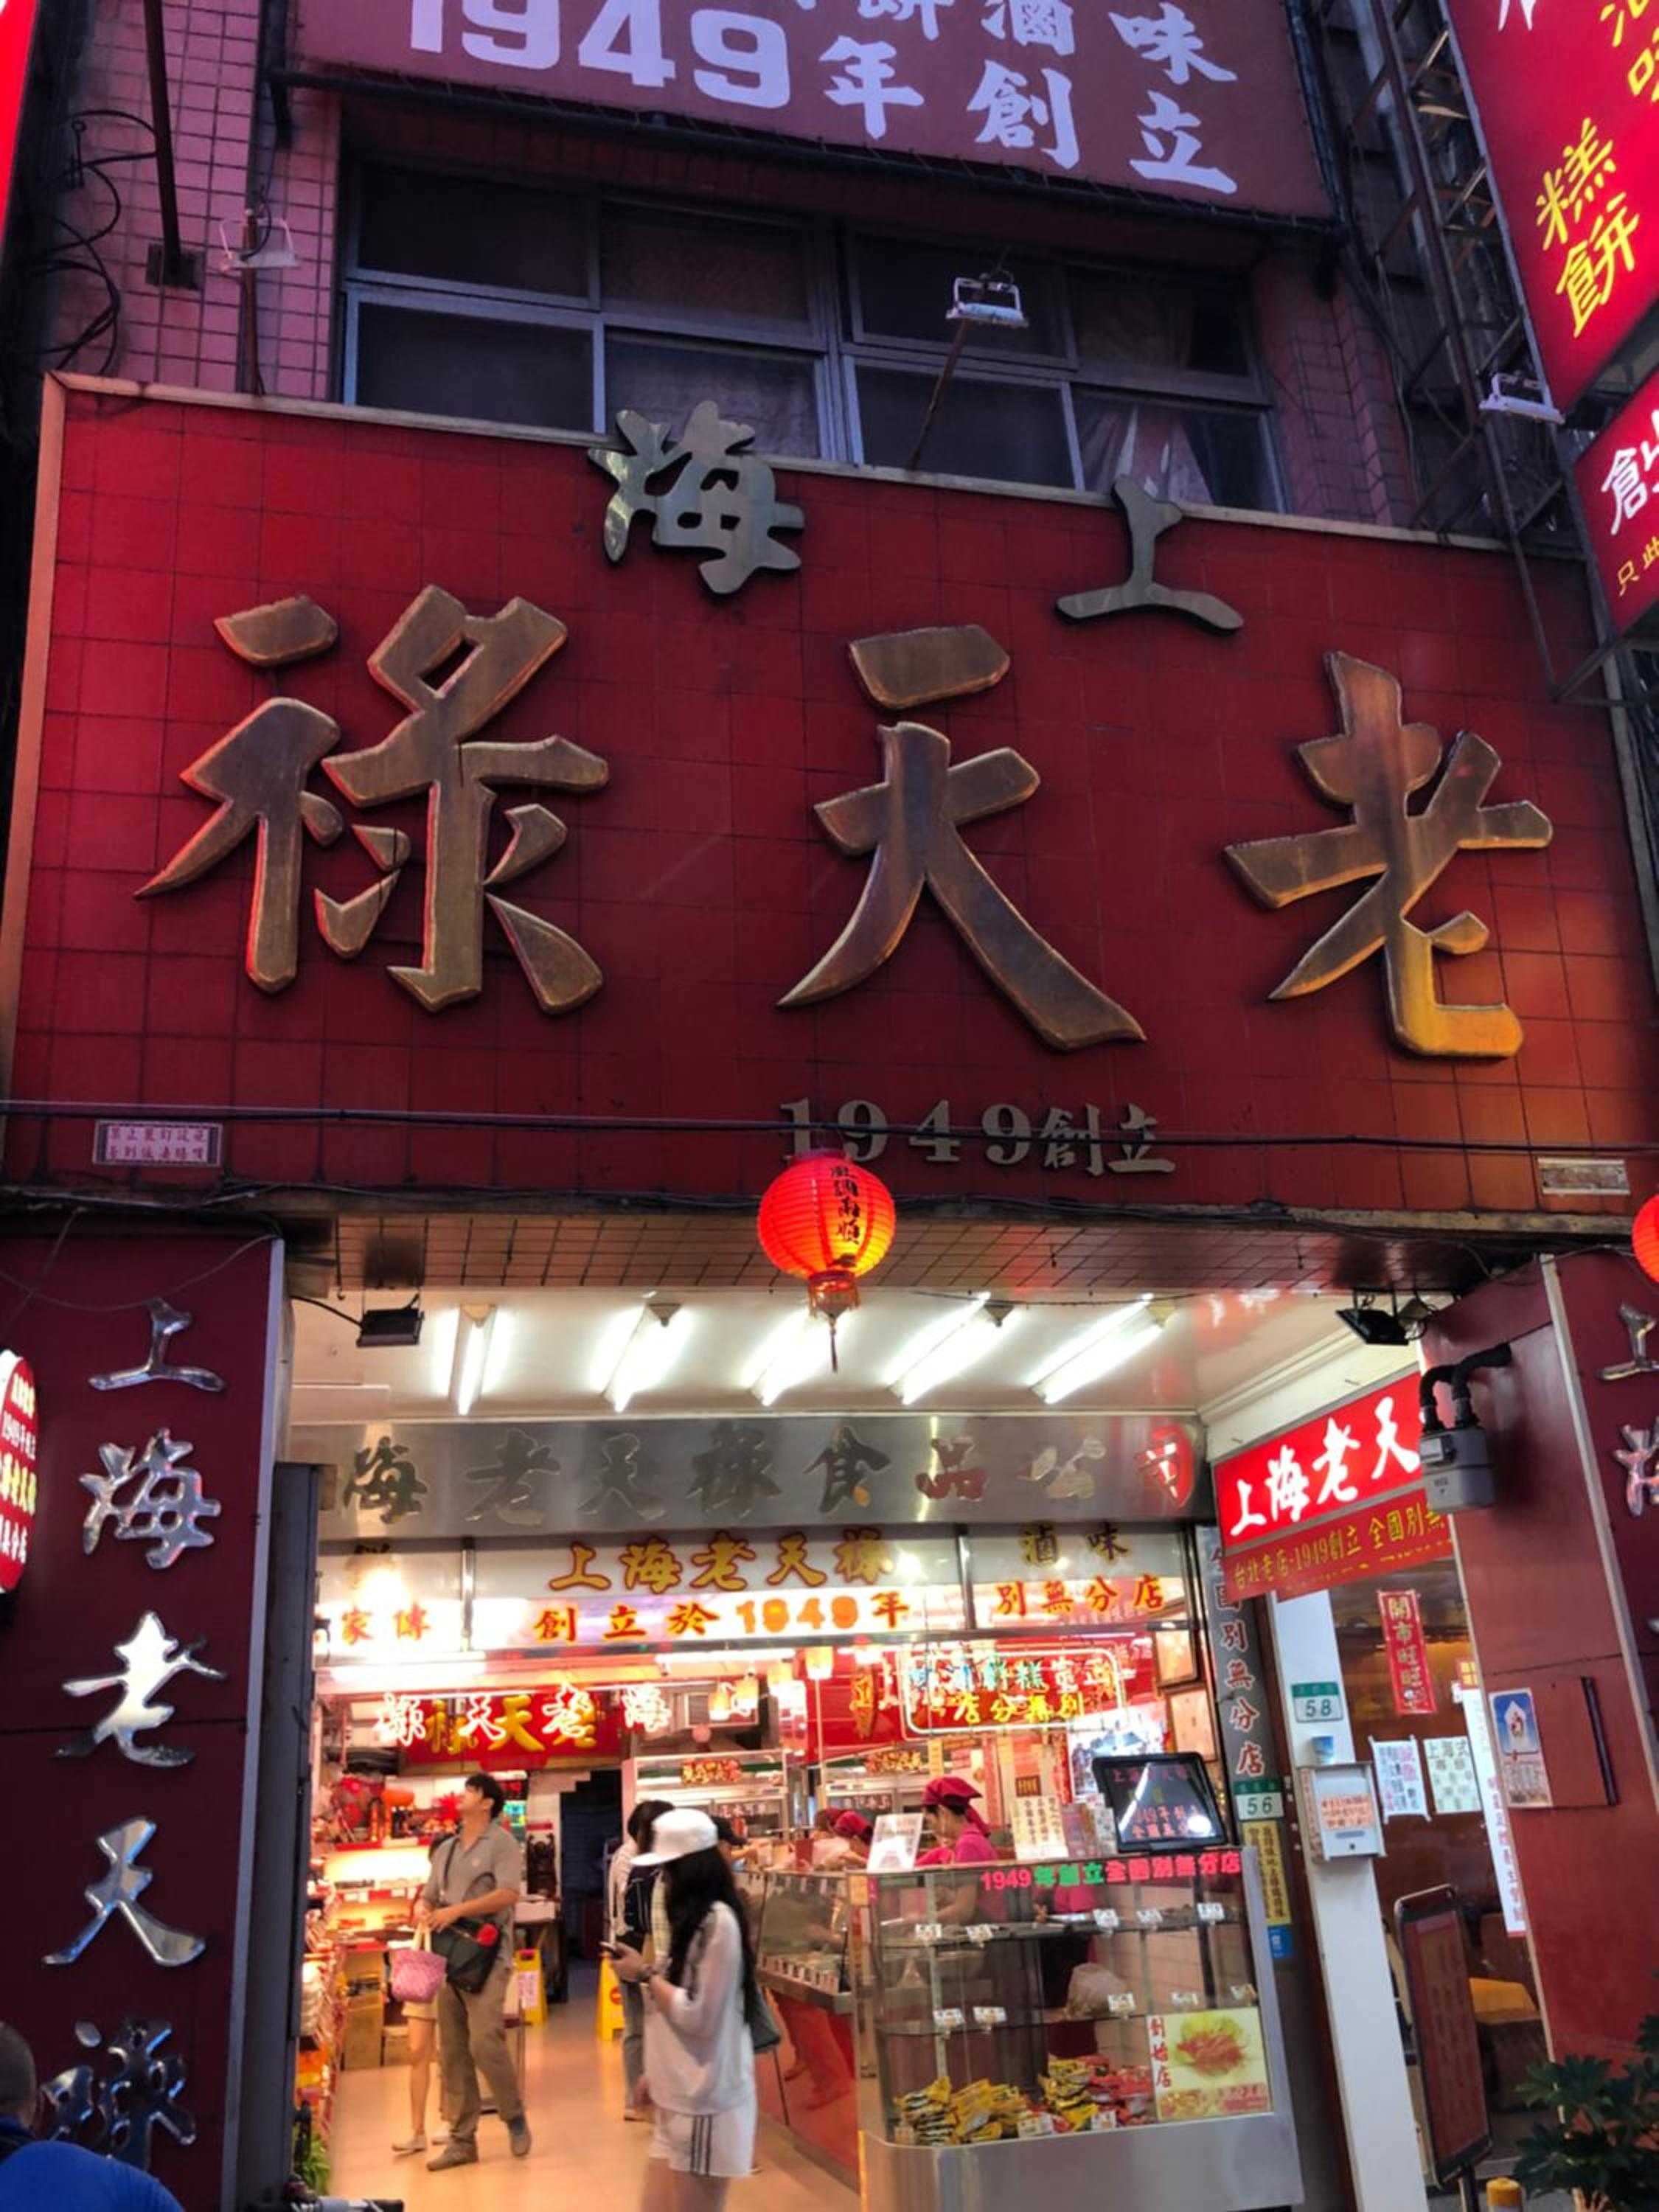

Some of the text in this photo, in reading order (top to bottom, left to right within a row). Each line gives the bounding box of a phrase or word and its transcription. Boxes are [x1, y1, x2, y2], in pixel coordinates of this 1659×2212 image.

[1536, 118, 1640, 338] 糕餅
[1229, 1396, 1426, 1537] 上海老天
[549, 1528, 894, 1595] 上海老天祿
[1022, 1522, 1130, 1568] 滷味
[532, 1590, 910, 1642] 創立於1949年
[995, 1573, 1166, 1617] 別無分店
[1305, 1699, 1332, 1718] 58
[1247, 1796, 1273, 1815] 56
